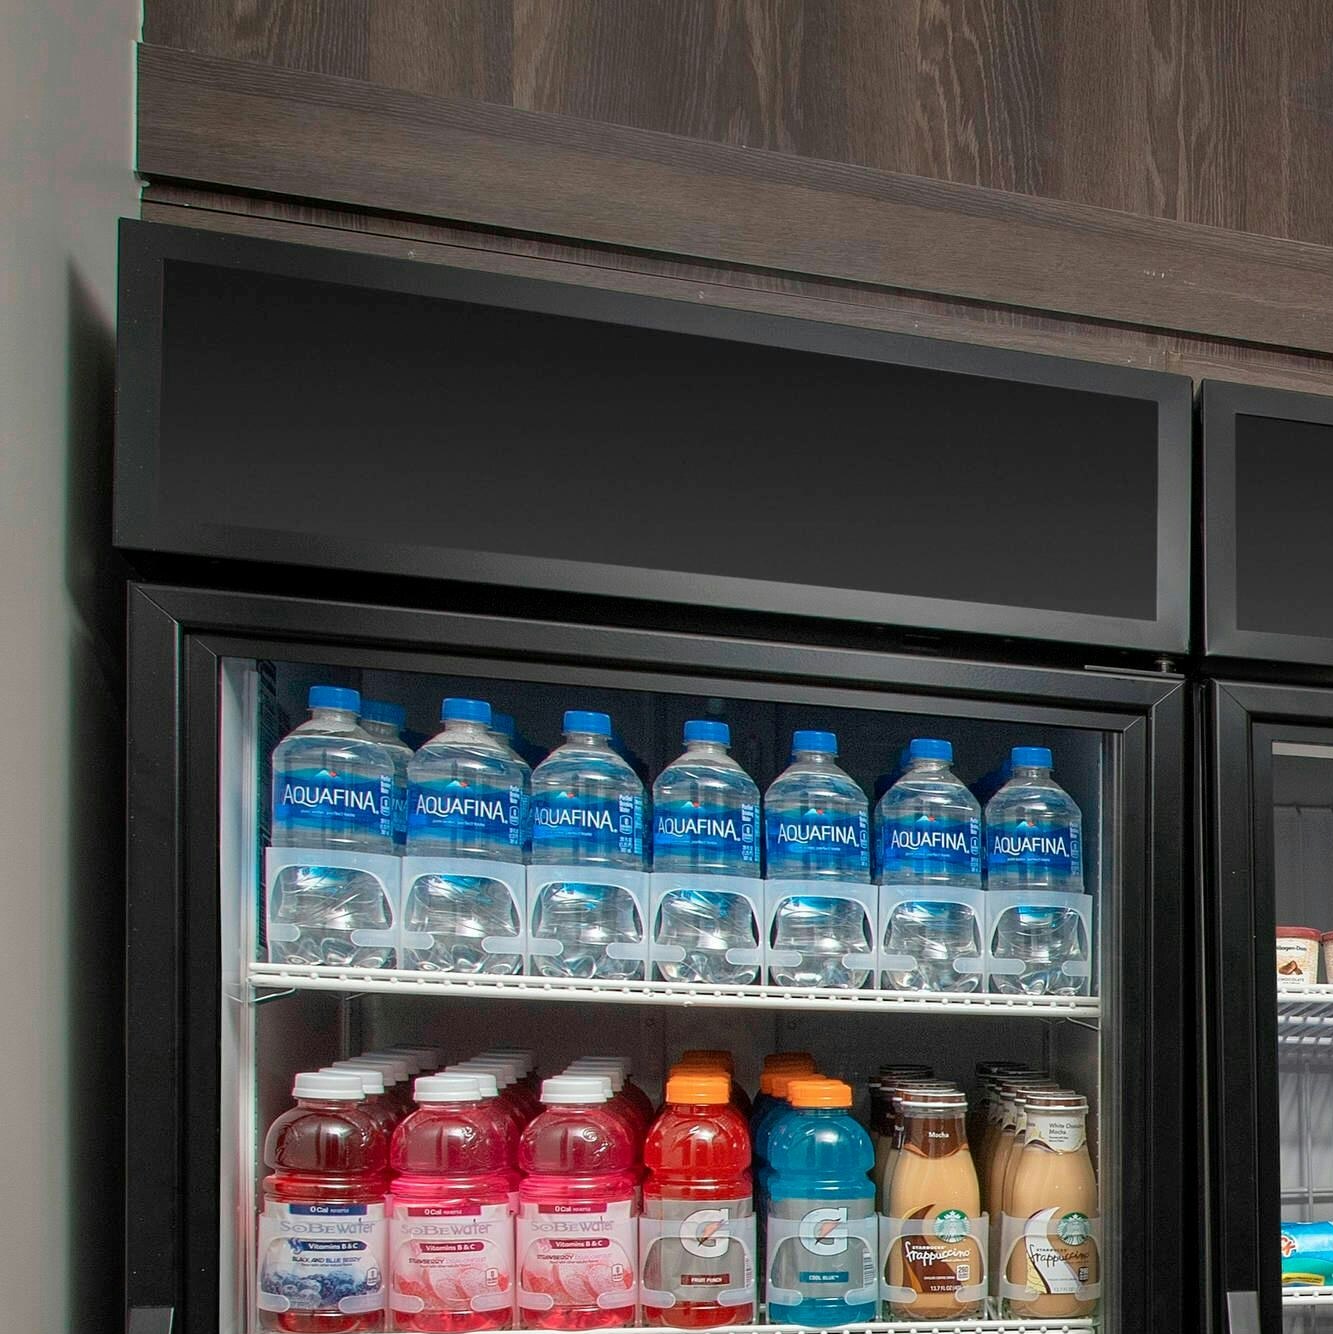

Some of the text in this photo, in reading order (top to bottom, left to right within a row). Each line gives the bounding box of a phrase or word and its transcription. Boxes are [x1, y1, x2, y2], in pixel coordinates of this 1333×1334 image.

[282, 784, 376, 814] AQUAFINA
[416, 793, 504, 822] AQUAFINA
[534, 806, 615, 831] AQUAFINA
[658, 816, 737, 839] AQUAFINA
[778, 823, 856, 846] AQUAFINA
[891, 831, 967, 851] AQUAFINA
[993, 835, 1068, 855] AQUAFINA
[680, 1208, 730, 1258] G
[800, 1208, 848, 1256] G
